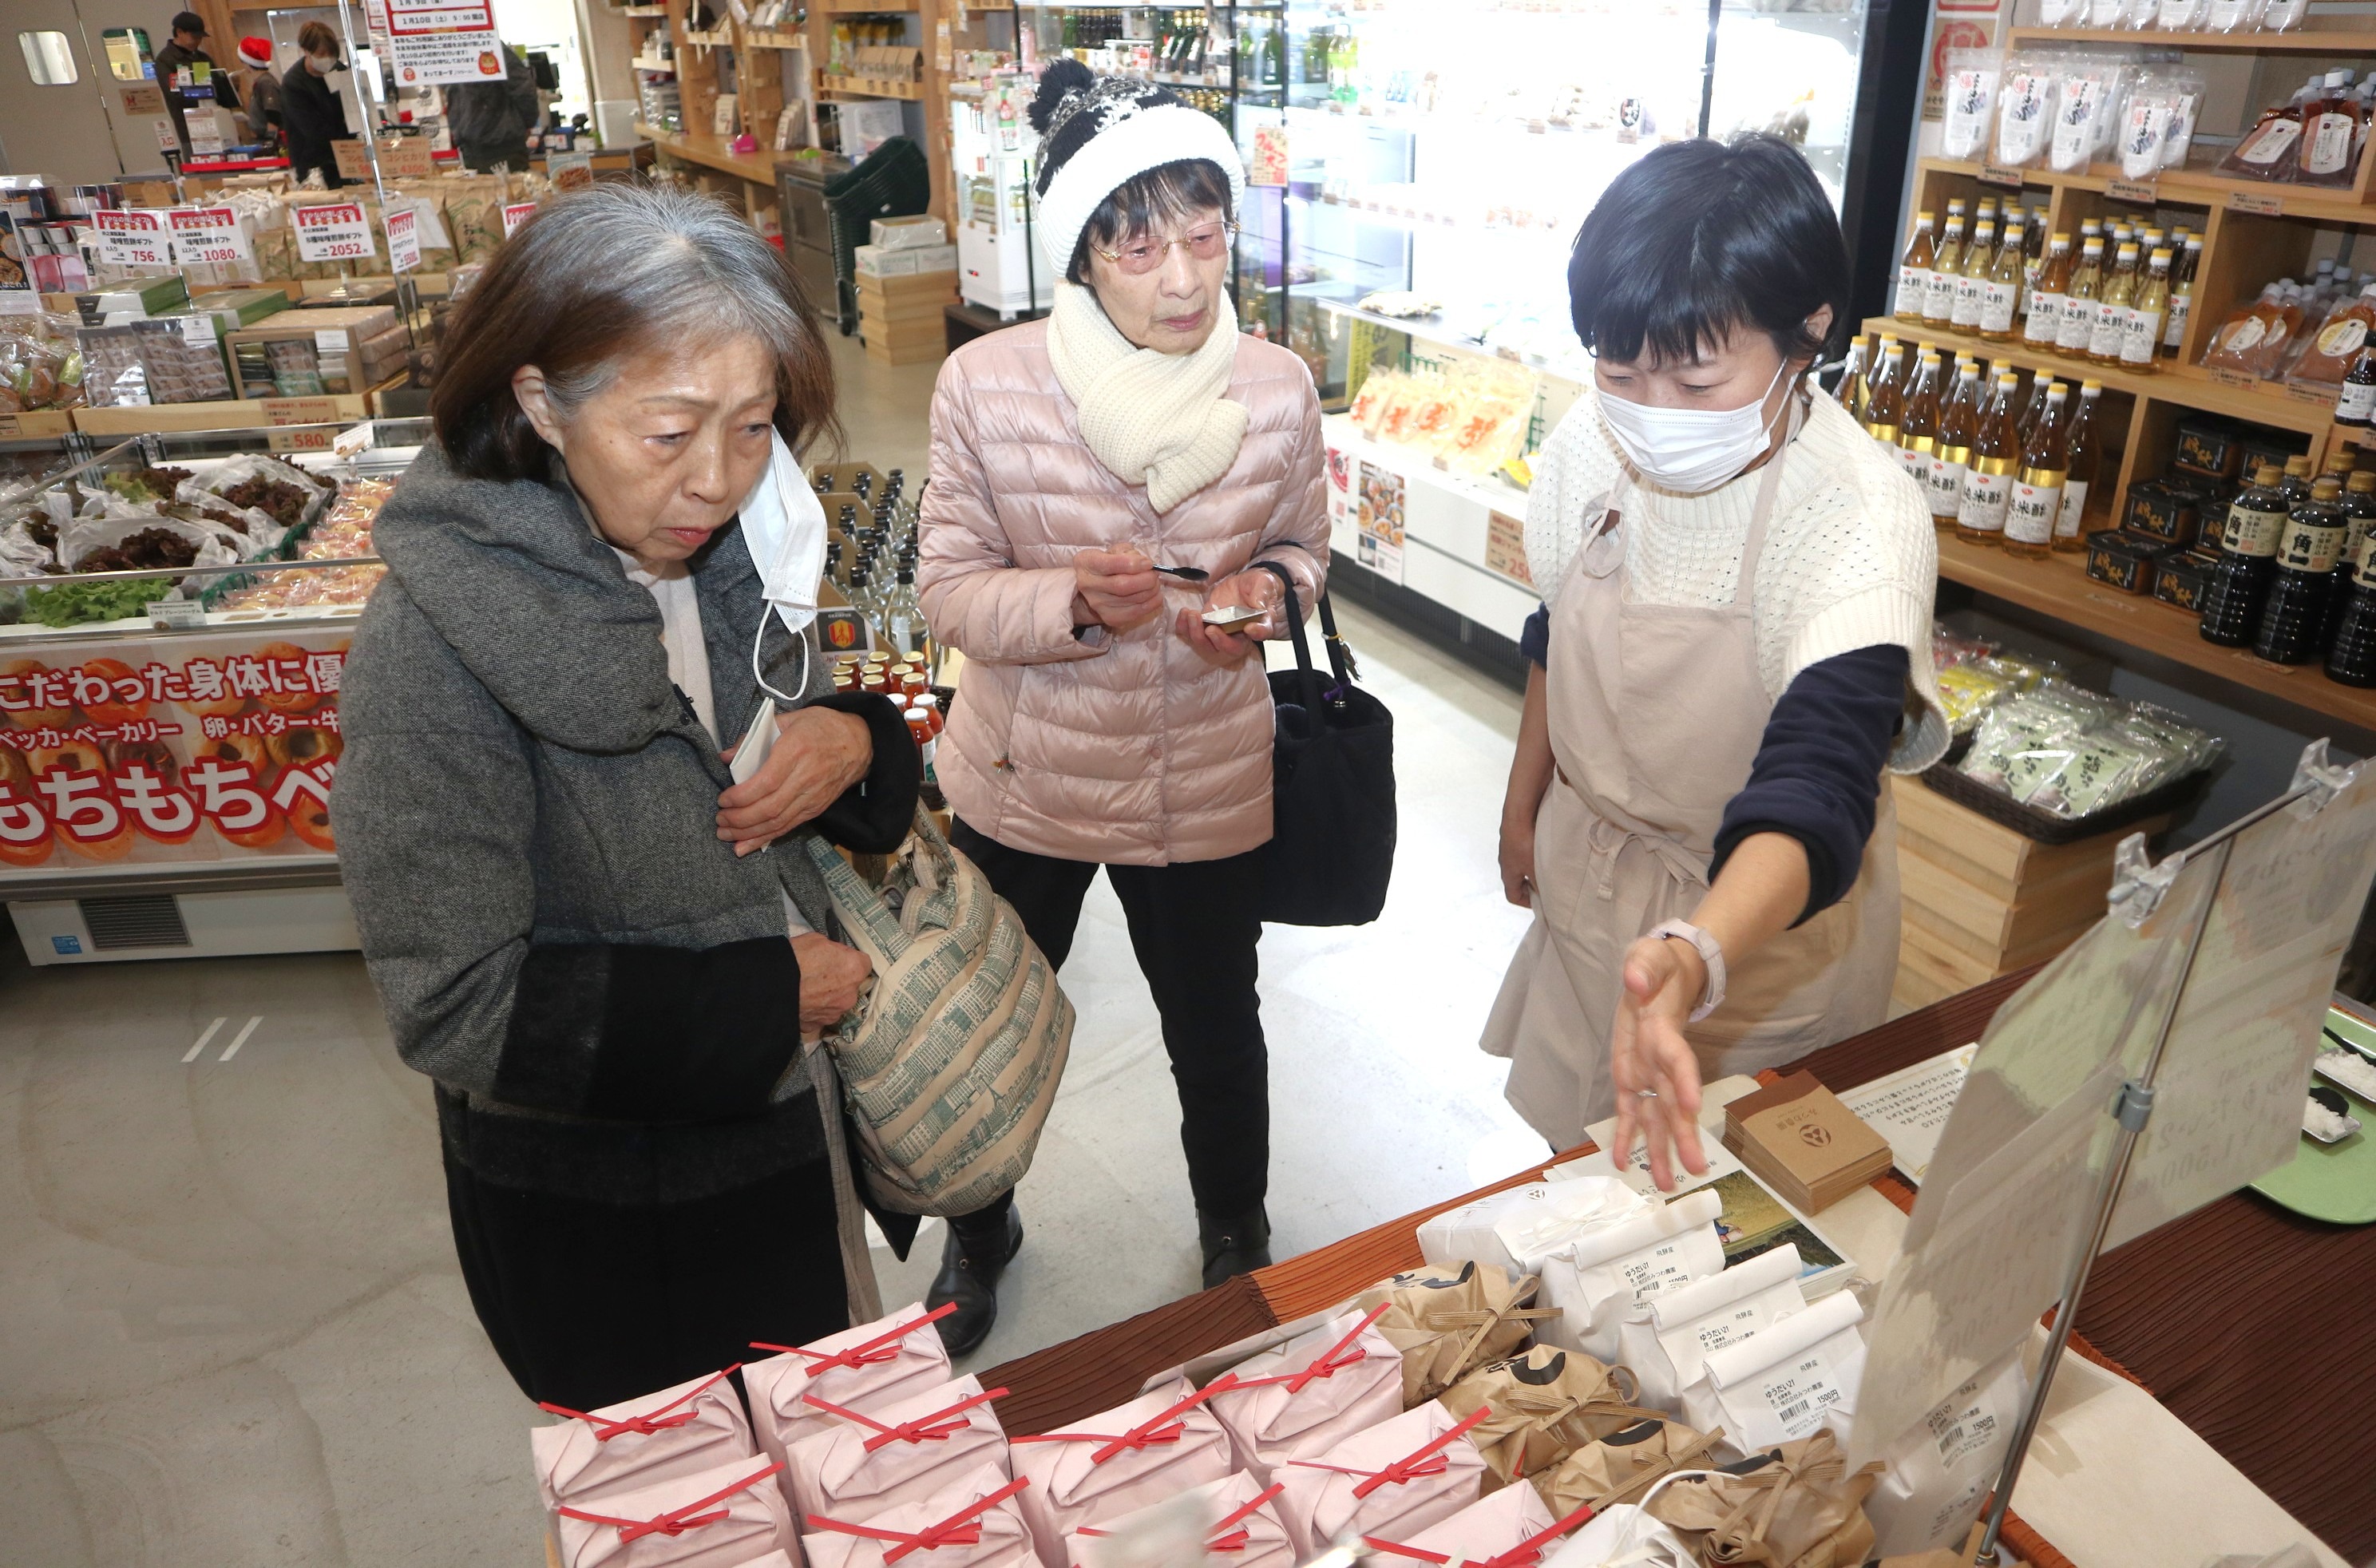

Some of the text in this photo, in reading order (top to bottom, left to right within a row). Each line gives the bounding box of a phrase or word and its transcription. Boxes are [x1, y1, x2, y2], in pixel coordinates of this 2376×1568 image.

[132, 251, 155, 262] 756
[204, 248, 236, 261] 1080
[329, 243, 362, 256] 2052
[294, 434, 325, 448] 580
[2288, 533, 2313, 566] 角一
[0, 653, 343, 710] こだわった身体に優
[1625, 1261, 1649, 1277] ゆうだい21
[1699, 1325, 1729, 1341] ゆうだい21
[1765, 1379, 1796, 1399] ゆうだい21
[1817, 1388, 1839, 1404] 1500円
[1973, 1416, 1994, 1431] 1500円
